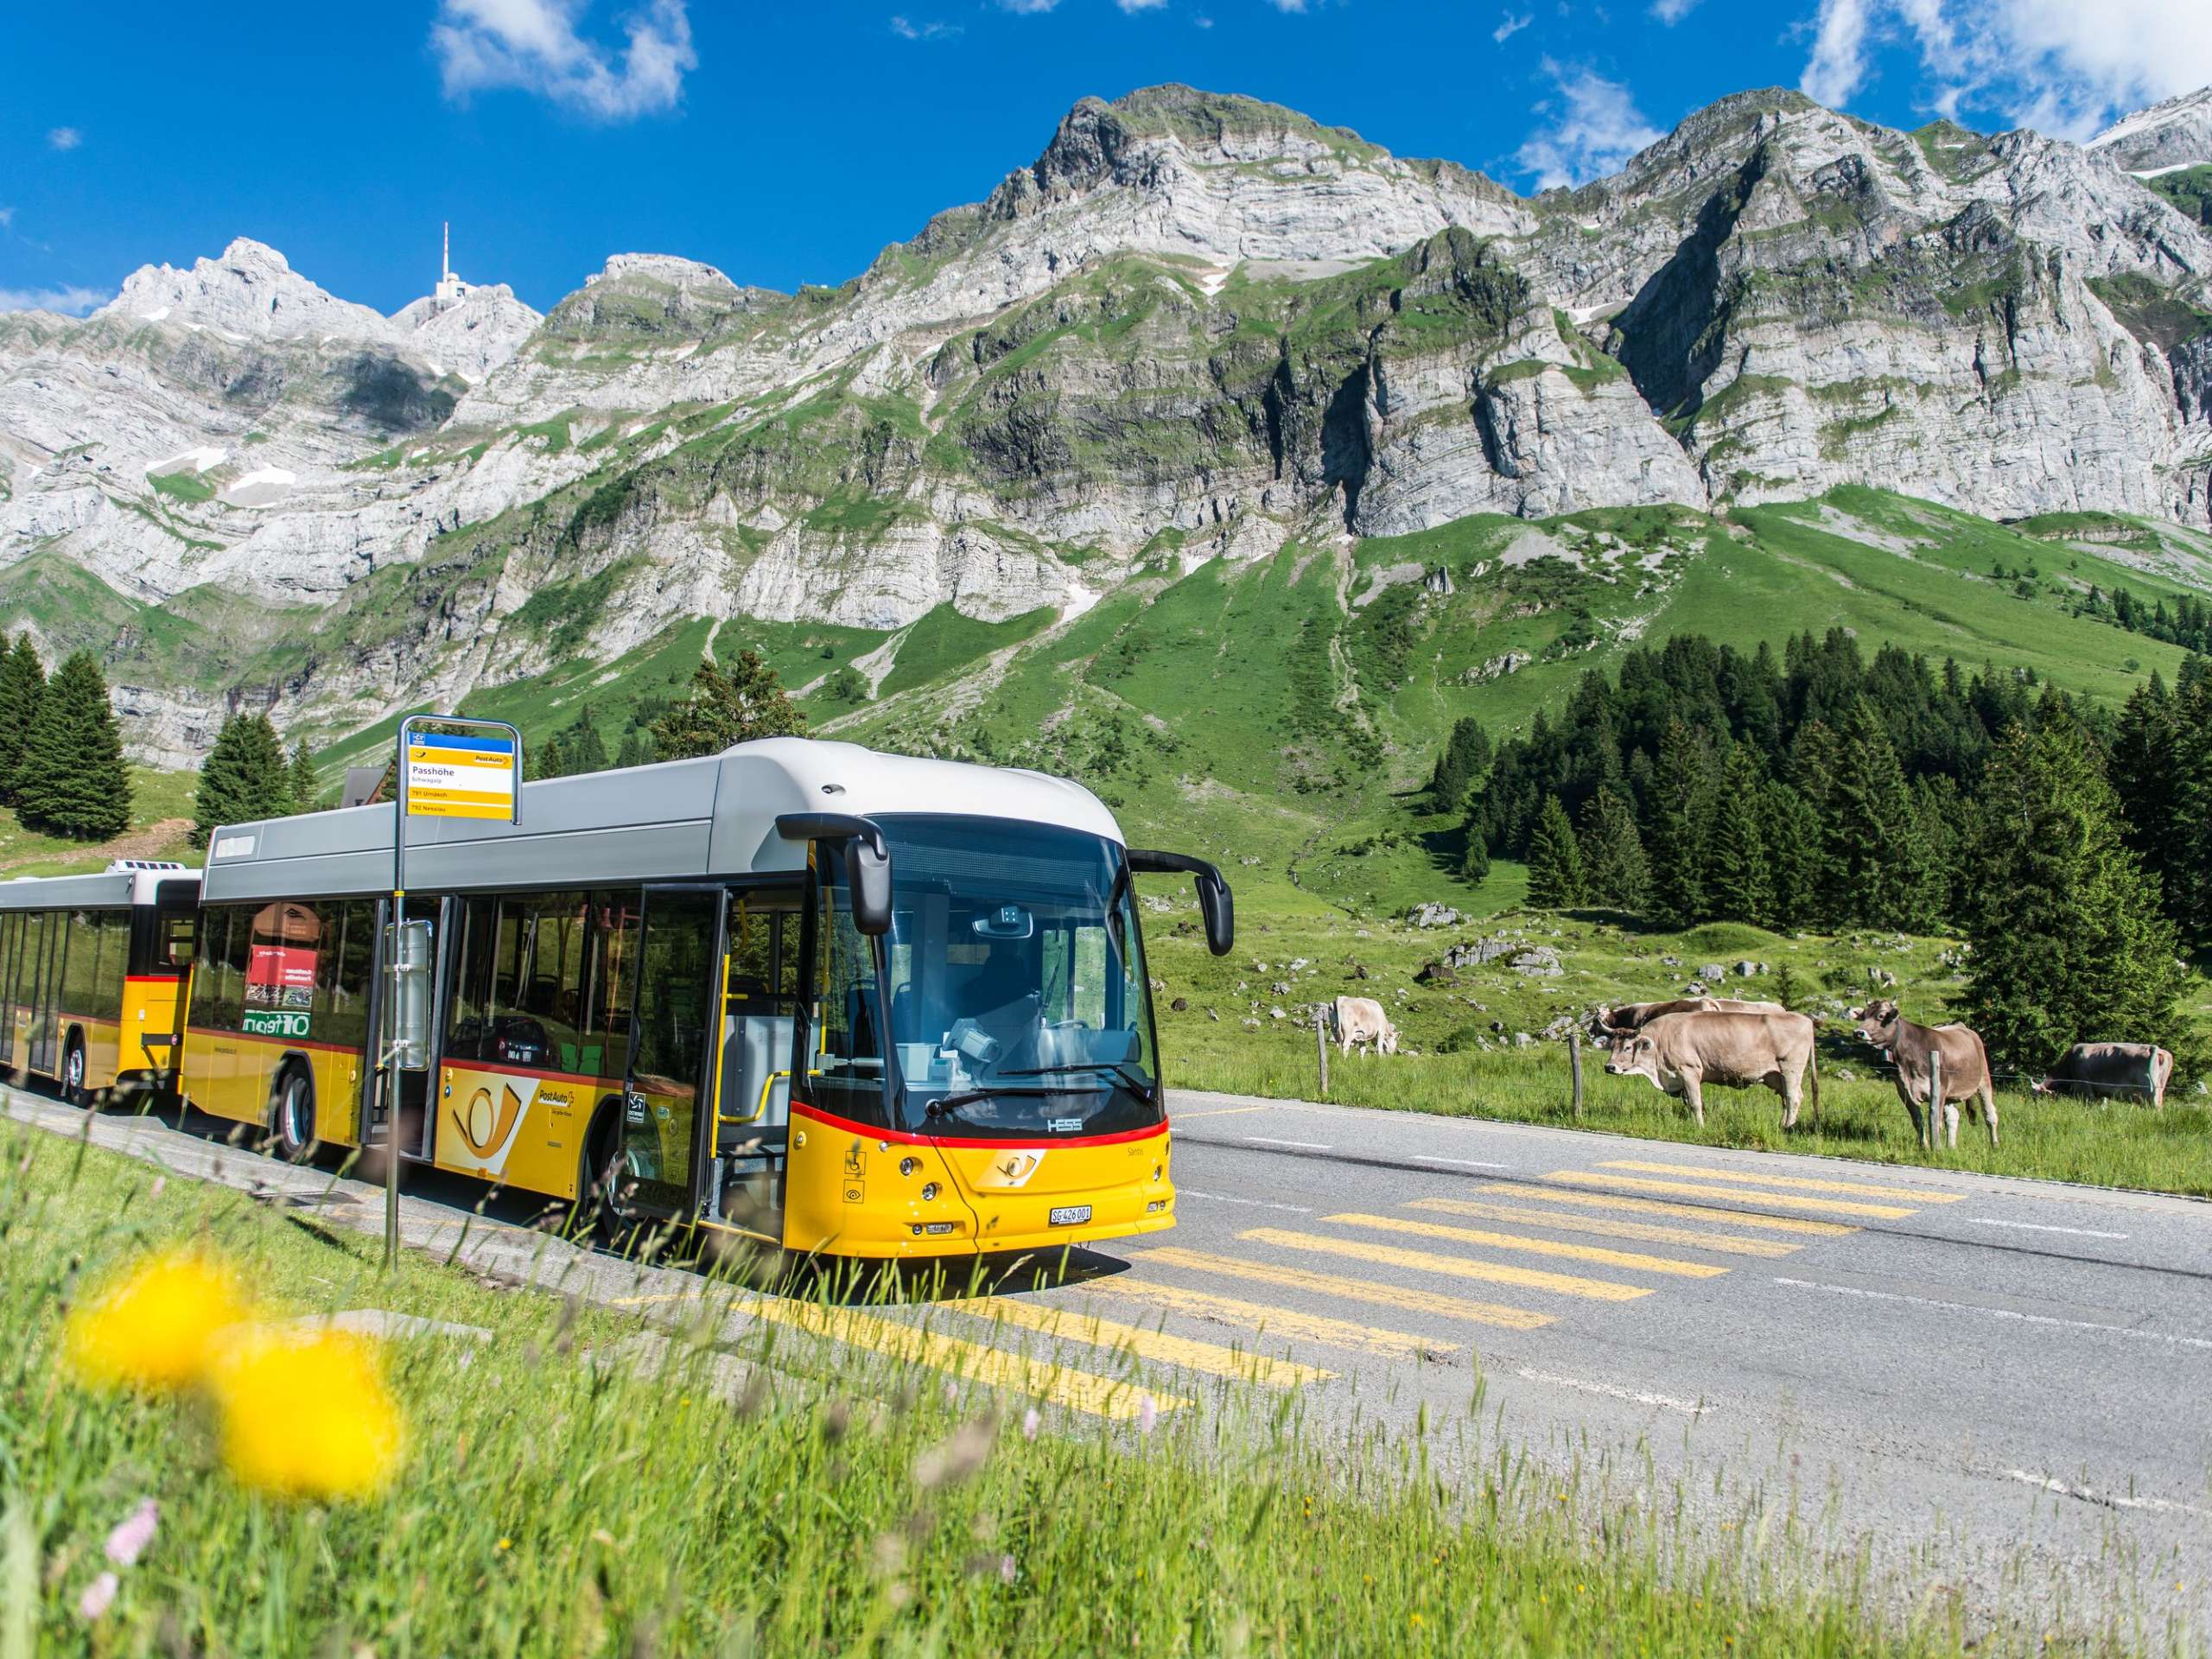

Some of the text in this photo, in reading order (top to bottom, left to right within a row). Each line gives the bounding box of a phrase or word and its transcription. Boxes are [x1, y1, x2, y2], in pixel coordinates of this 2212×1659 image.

[412, 766, 454, 777] Passhöhe
[539, 1090, 568, 1103] PostAuto
[1047, 1118, 1083, 1132] HESS
